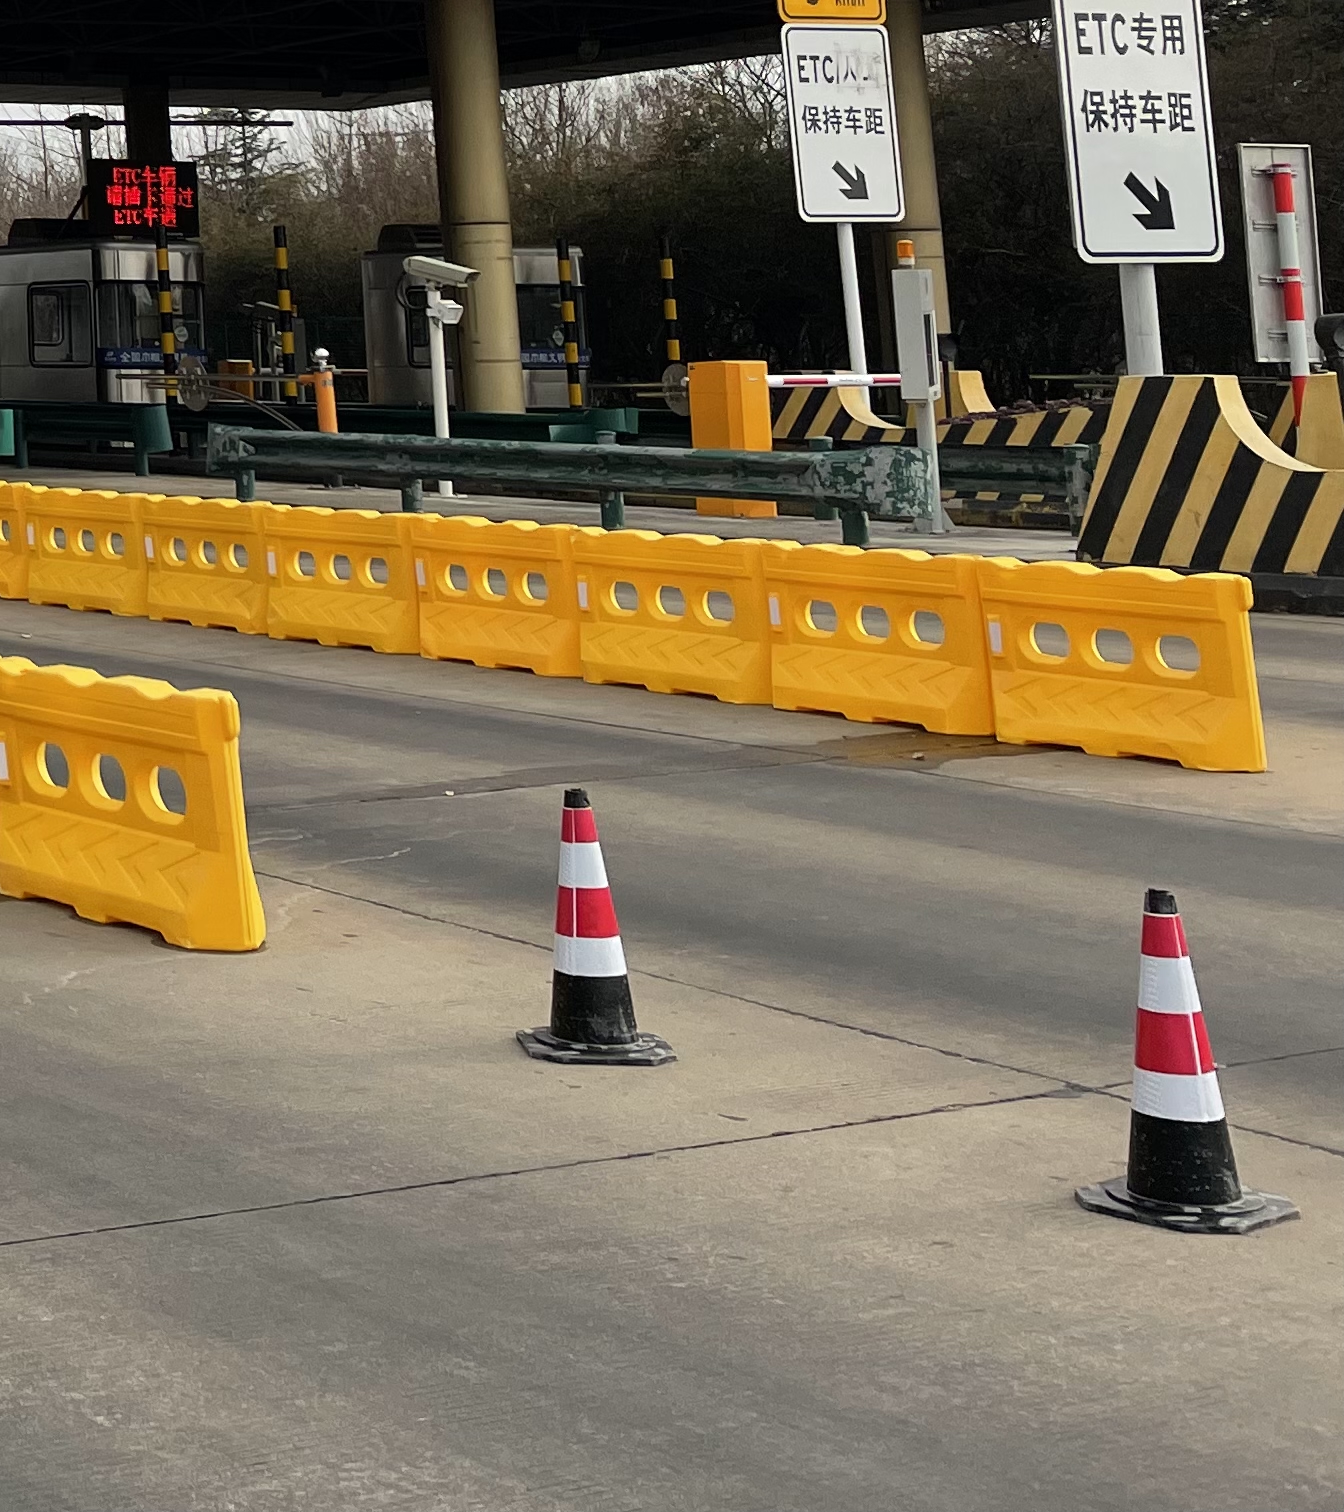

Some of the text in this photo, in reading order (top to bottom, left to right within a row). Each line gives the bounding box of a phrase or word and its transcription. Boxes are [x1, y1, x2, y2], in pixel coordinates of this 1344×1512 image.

[801, 104, 886, 135] 保持车距
[1081, 89, 1196, 133] 保持车距
